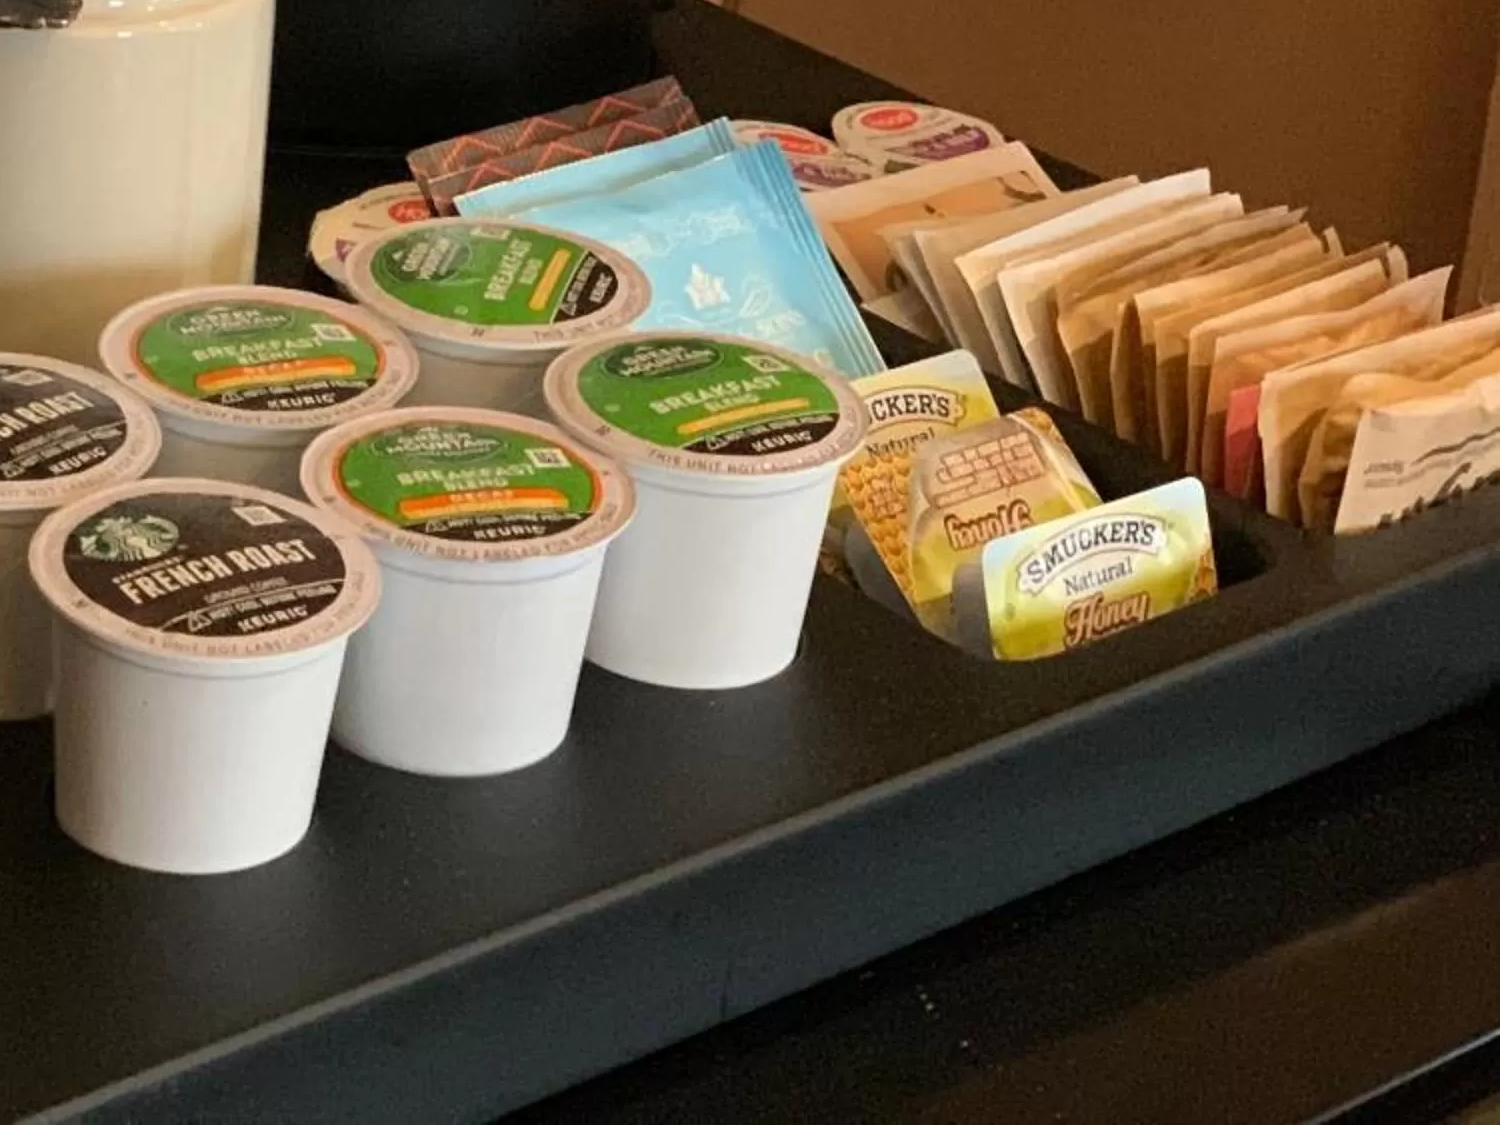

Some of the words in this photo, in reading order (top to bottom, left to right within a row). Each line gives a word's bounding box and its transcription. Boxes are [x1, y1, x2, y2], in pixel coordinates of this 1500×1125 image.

[191, 336, 324, 363] BREAKFAST
[13, 390, 95, 426] ROAST
[650, 374, 782, 415] BREAKFAST
[867, 393, 949, 424] CKER'S
[750, 430, 813, 453] KEURIG
[864, 427, 936, 456] Natural
[396, 463, 535, 486] BREAKFAST
[473, 525, 546, 540] KEURIG
[1026, 519, 1157, 586] SMUCKER'S
[118, 554, 234, 605] FRENCH
[225, 539, 317, 573] ROAST
[1062, 555, 1134, 597] Natural
[237, 605, 309, 633] KEURIG
[1063, 591, 1151, 648] Honey
